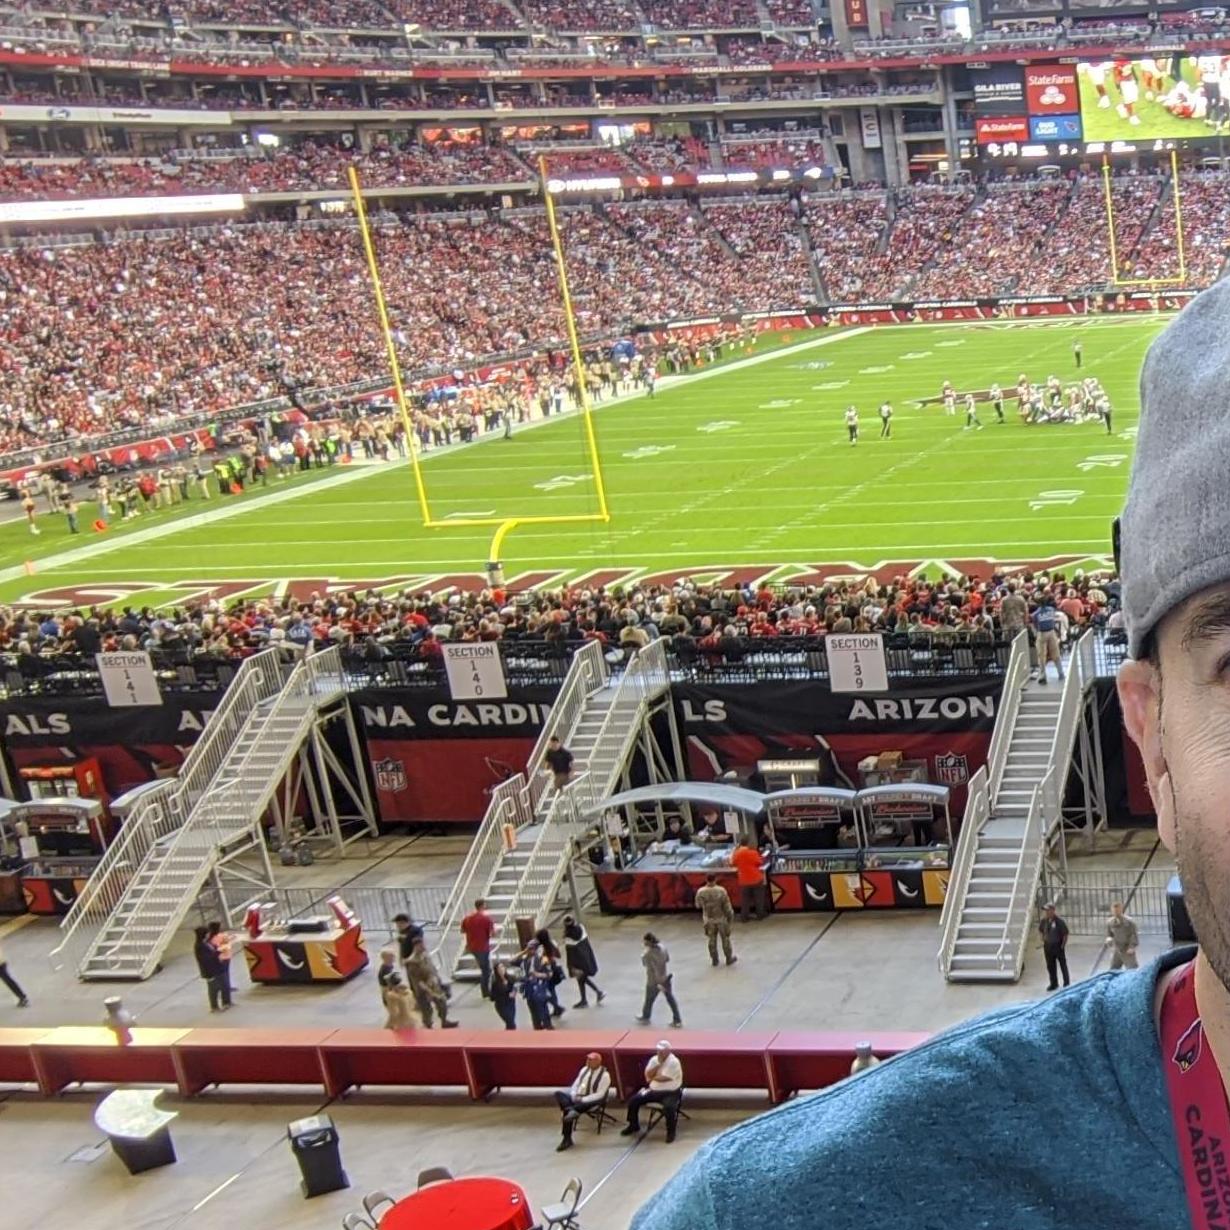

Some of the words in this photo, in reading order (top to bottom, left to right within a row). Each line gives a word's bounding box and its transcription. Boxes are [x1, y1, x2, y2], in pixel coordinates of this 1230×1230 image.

[974, 84, 995, 92] GILA
[995, 83, 1021, 91] RIVER
[831, 637, 879, 649] SECTION
[447, 645, 494, 657] SECTION
[102, 656, 147, 666] SECTION
